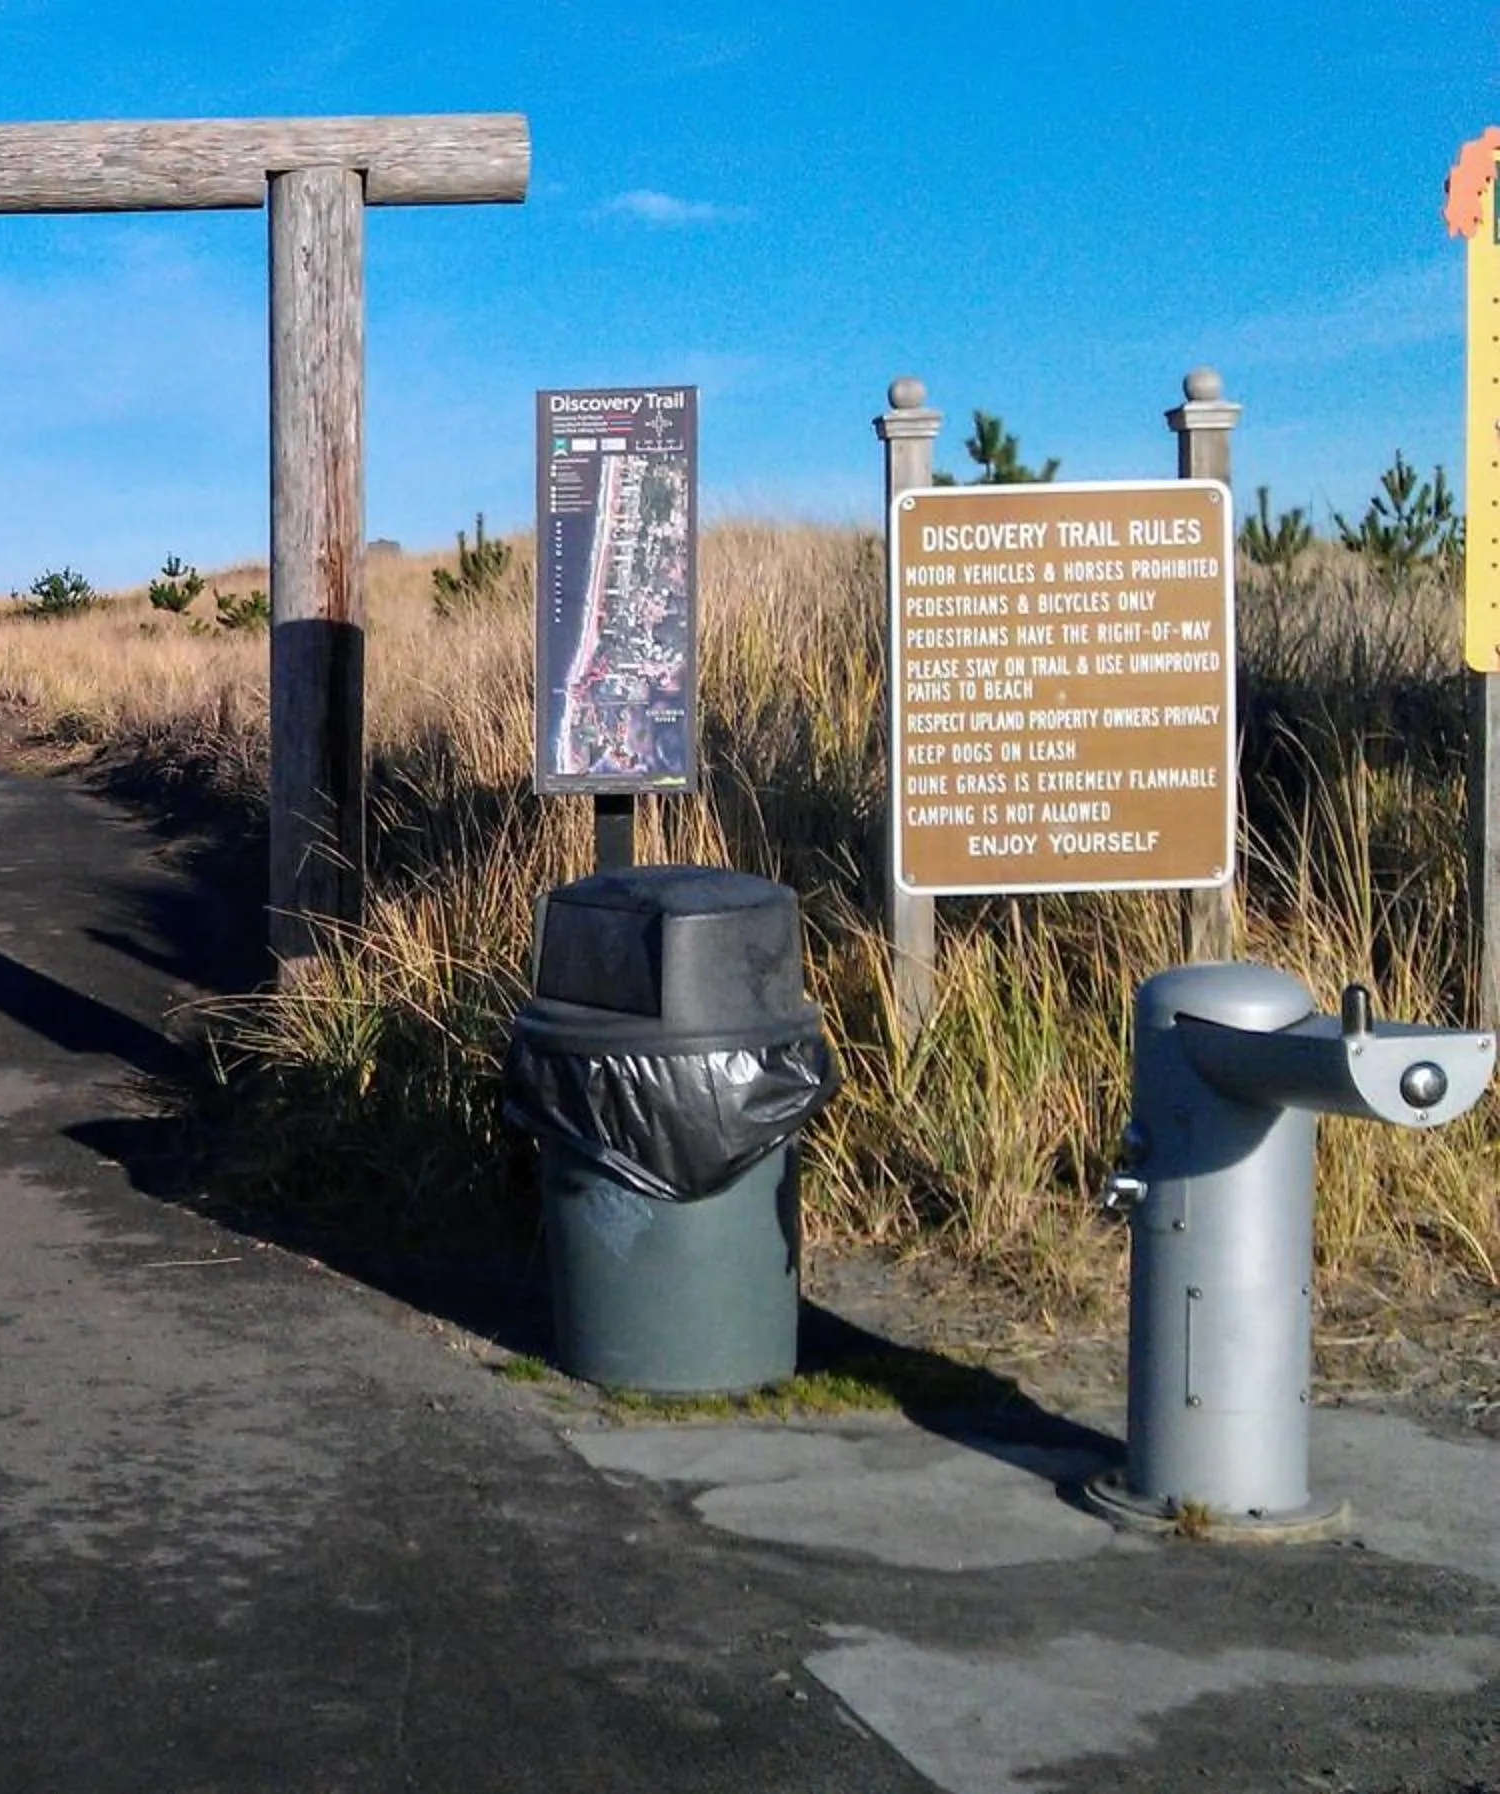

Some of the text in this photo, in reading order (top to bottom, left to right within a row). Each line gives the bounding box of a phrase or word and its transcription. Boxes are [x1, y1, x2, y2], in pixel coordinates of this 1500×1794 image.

[551, 392, 685, 413] Discovery Trail
[922, 518, 1201, 553] DISCOVERY TRAIL RULES
[906, 558, 1218, 586] MOTOR VEHICLES & HORSES PROHIBITED
[907, 591, 1156, 617] PEDESTRIANS & BICYCLES ONLY
[907, 621, 1211, 648] PEDESTRIANS HAVE THE RIGHT-OF-WAY
[907, 651, 1220, 679] PLEASE STAY ON TRAIL & USE UNIMPROVED
[907, 679, 1033, 702] PATHS TO BEACH
[908, 705, 1220, 733] RESPECT UPLAND PROPERTY OWNERS PRIVACY
[908, 740, 1076, 765] KEEP DOGS ON LEASH
[908, 767, 1217, 795] DUNE GRASS IS EXTREMELY FLAMMABLE
[908, 800, 1111, 826] CAMPING IS NOT ALLOWED
[968, 831, 1160, 856] ENJOY YOURSELF
